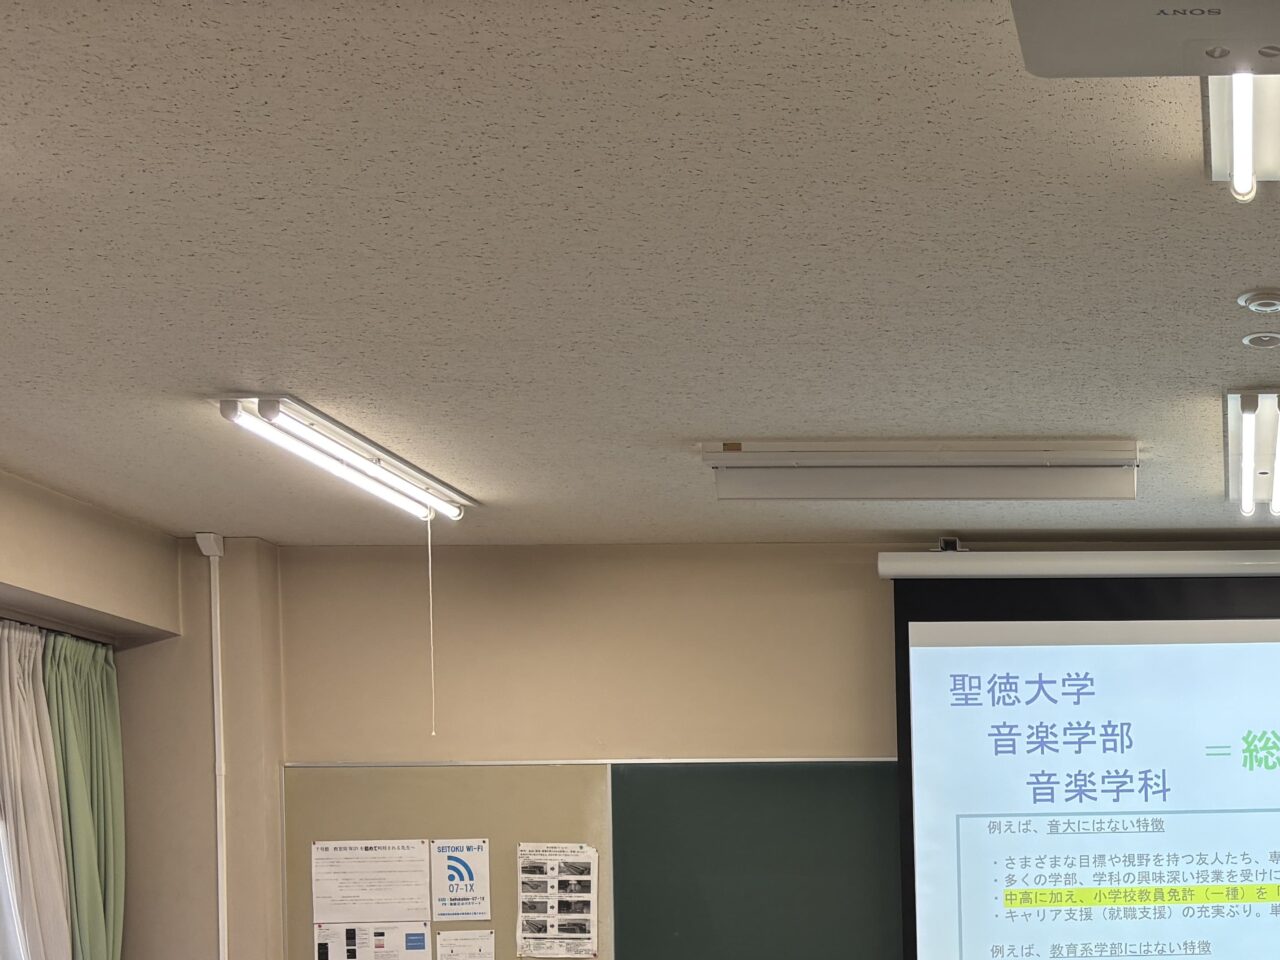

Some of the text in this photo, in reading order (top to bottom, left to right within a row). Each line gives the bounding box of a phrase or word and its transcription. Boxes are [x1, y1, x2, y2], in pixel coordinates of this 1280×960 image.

[1157, 8, 1222, 16] SONY
[950, 672, 1096, 707] 聖徳大学
[987, 720, 1134, 756] 音楽学部
[1026, 768, 1171, 805] 音楽学科
[987, 818, 1165, 834] 例えば、音大にはない特徴
[437, 844, 483, 853] SEITOKU Wi-Fi
[448, 883, 475, 893] 07-1X
[990, 940, 1212, 959] 例えば、教育系学部にはない特徴
